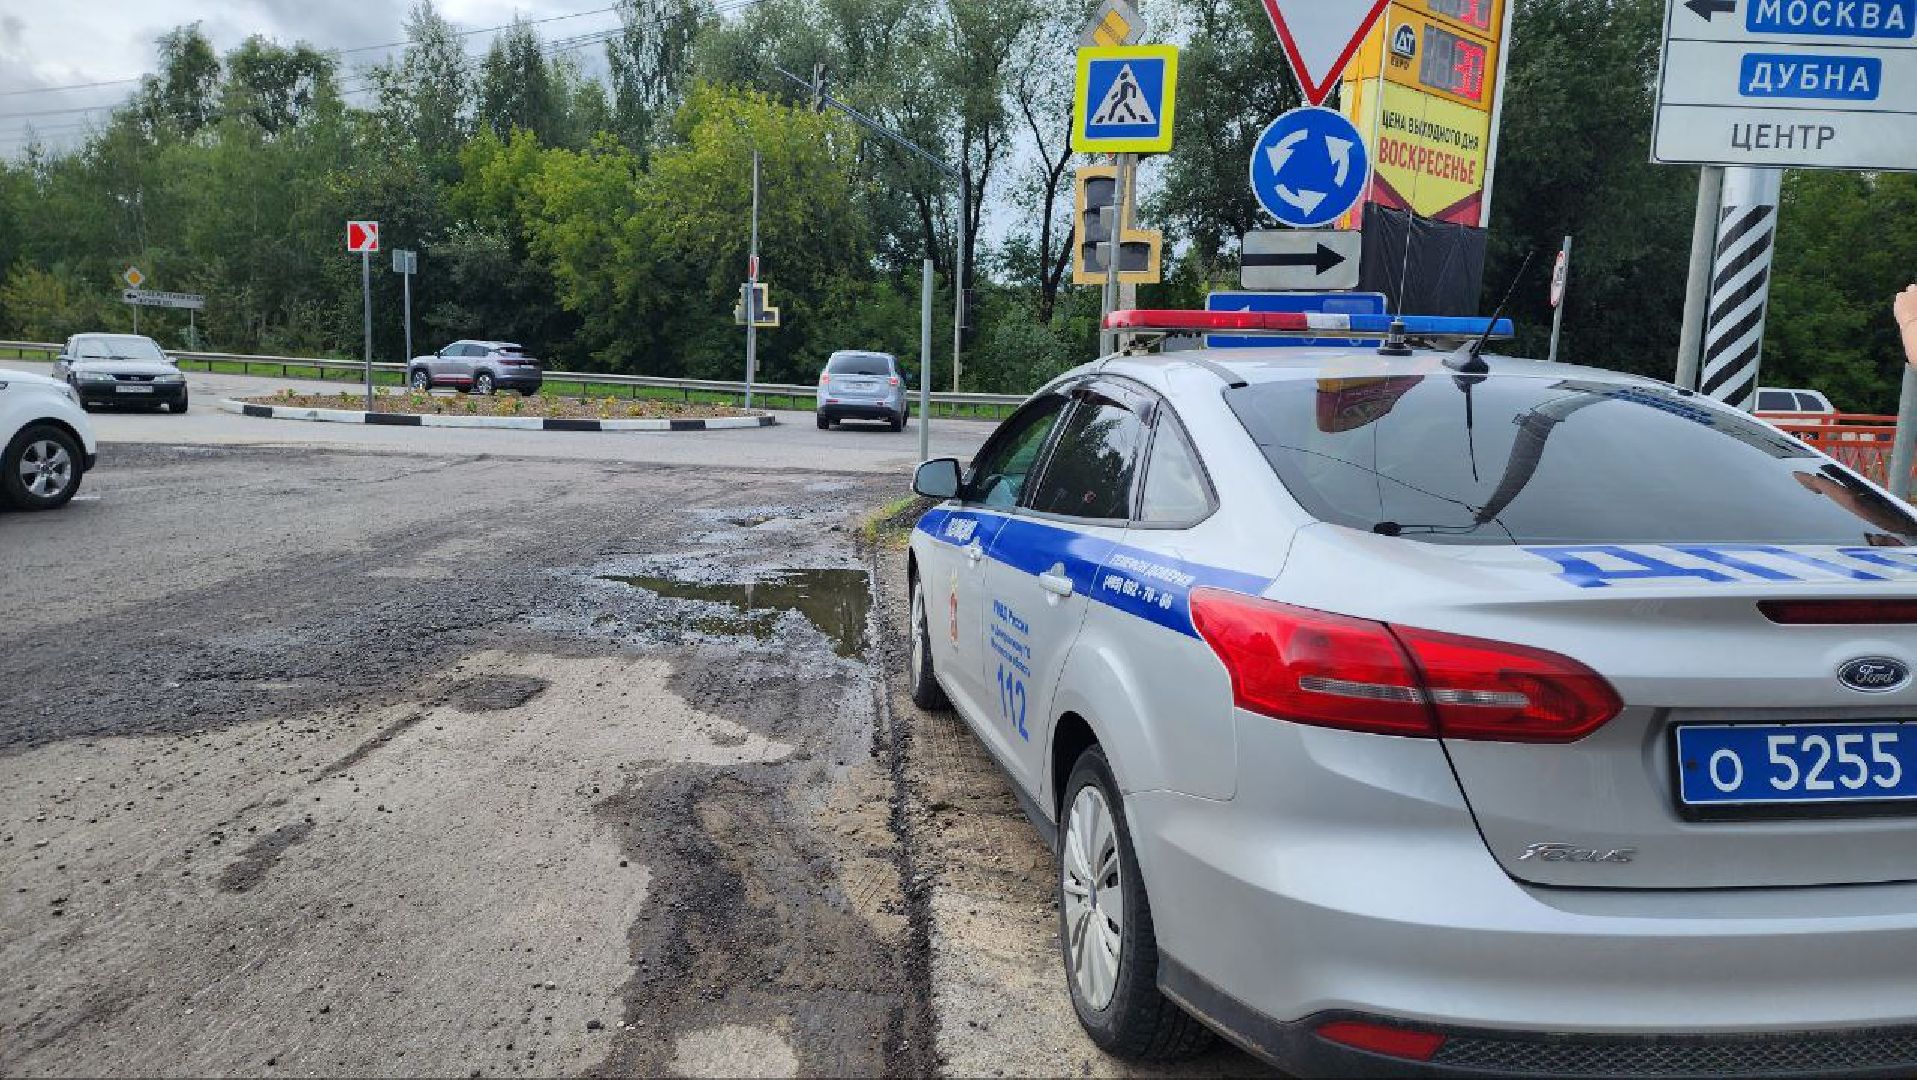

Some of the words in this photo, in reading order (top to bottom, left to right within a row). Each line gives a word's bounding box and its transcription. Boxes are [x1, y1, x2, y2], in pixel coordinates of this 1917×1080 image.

[1755, 0, 1906, 30] МОСКВА
[1748, 63, 1870, 92] ДУБНА
[1382, 109, 1406, 131] ЦЕНА
[1460, 132, 1479, 151] ДНЯ
[1731, 123, 1835, 151] ЦЕНТР
[1378, 136, 1476, 185] ВОСКРЕСЕНЬЕ
[1856, 664, 1895, 684] Ford
[997, 662, 1029, 742] 112
[1767, 732, 1902, 791] 5255
